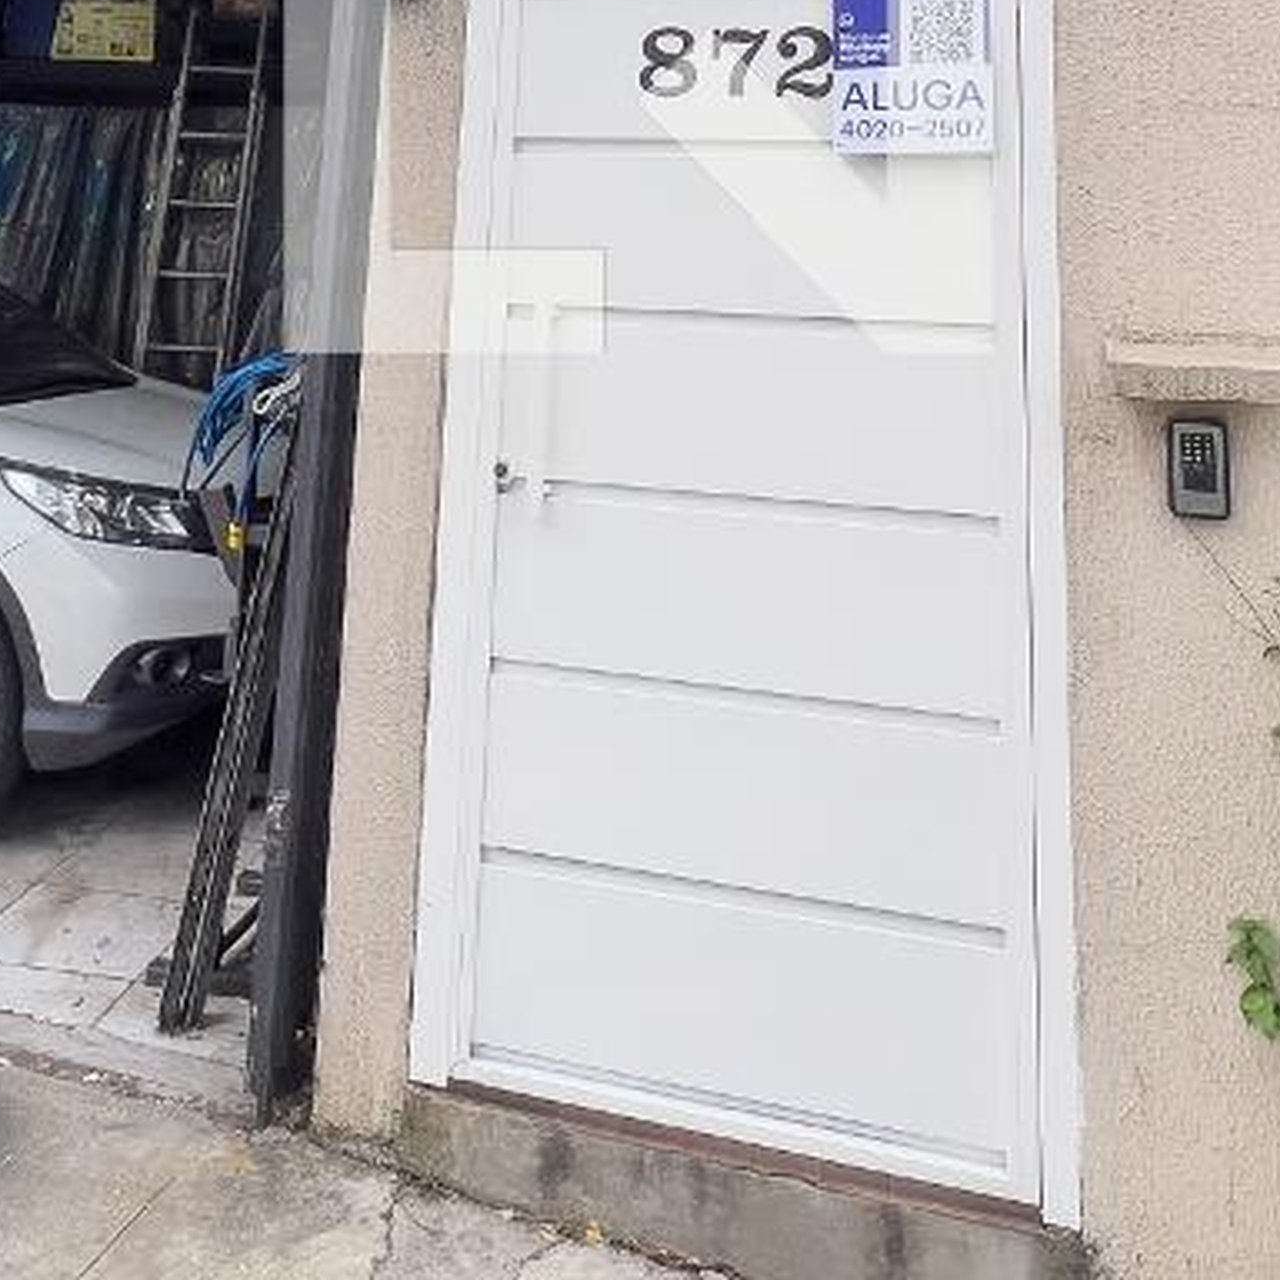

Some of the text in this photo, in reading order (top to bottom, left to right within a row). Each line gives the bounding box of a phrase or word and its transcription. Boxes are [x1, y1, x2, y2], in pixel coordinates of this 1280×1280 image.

[638, 25, 834, 99] 872
[842, 78, 985, 112] ALUGA
[839, 118, 985, 141] 4020-2507
